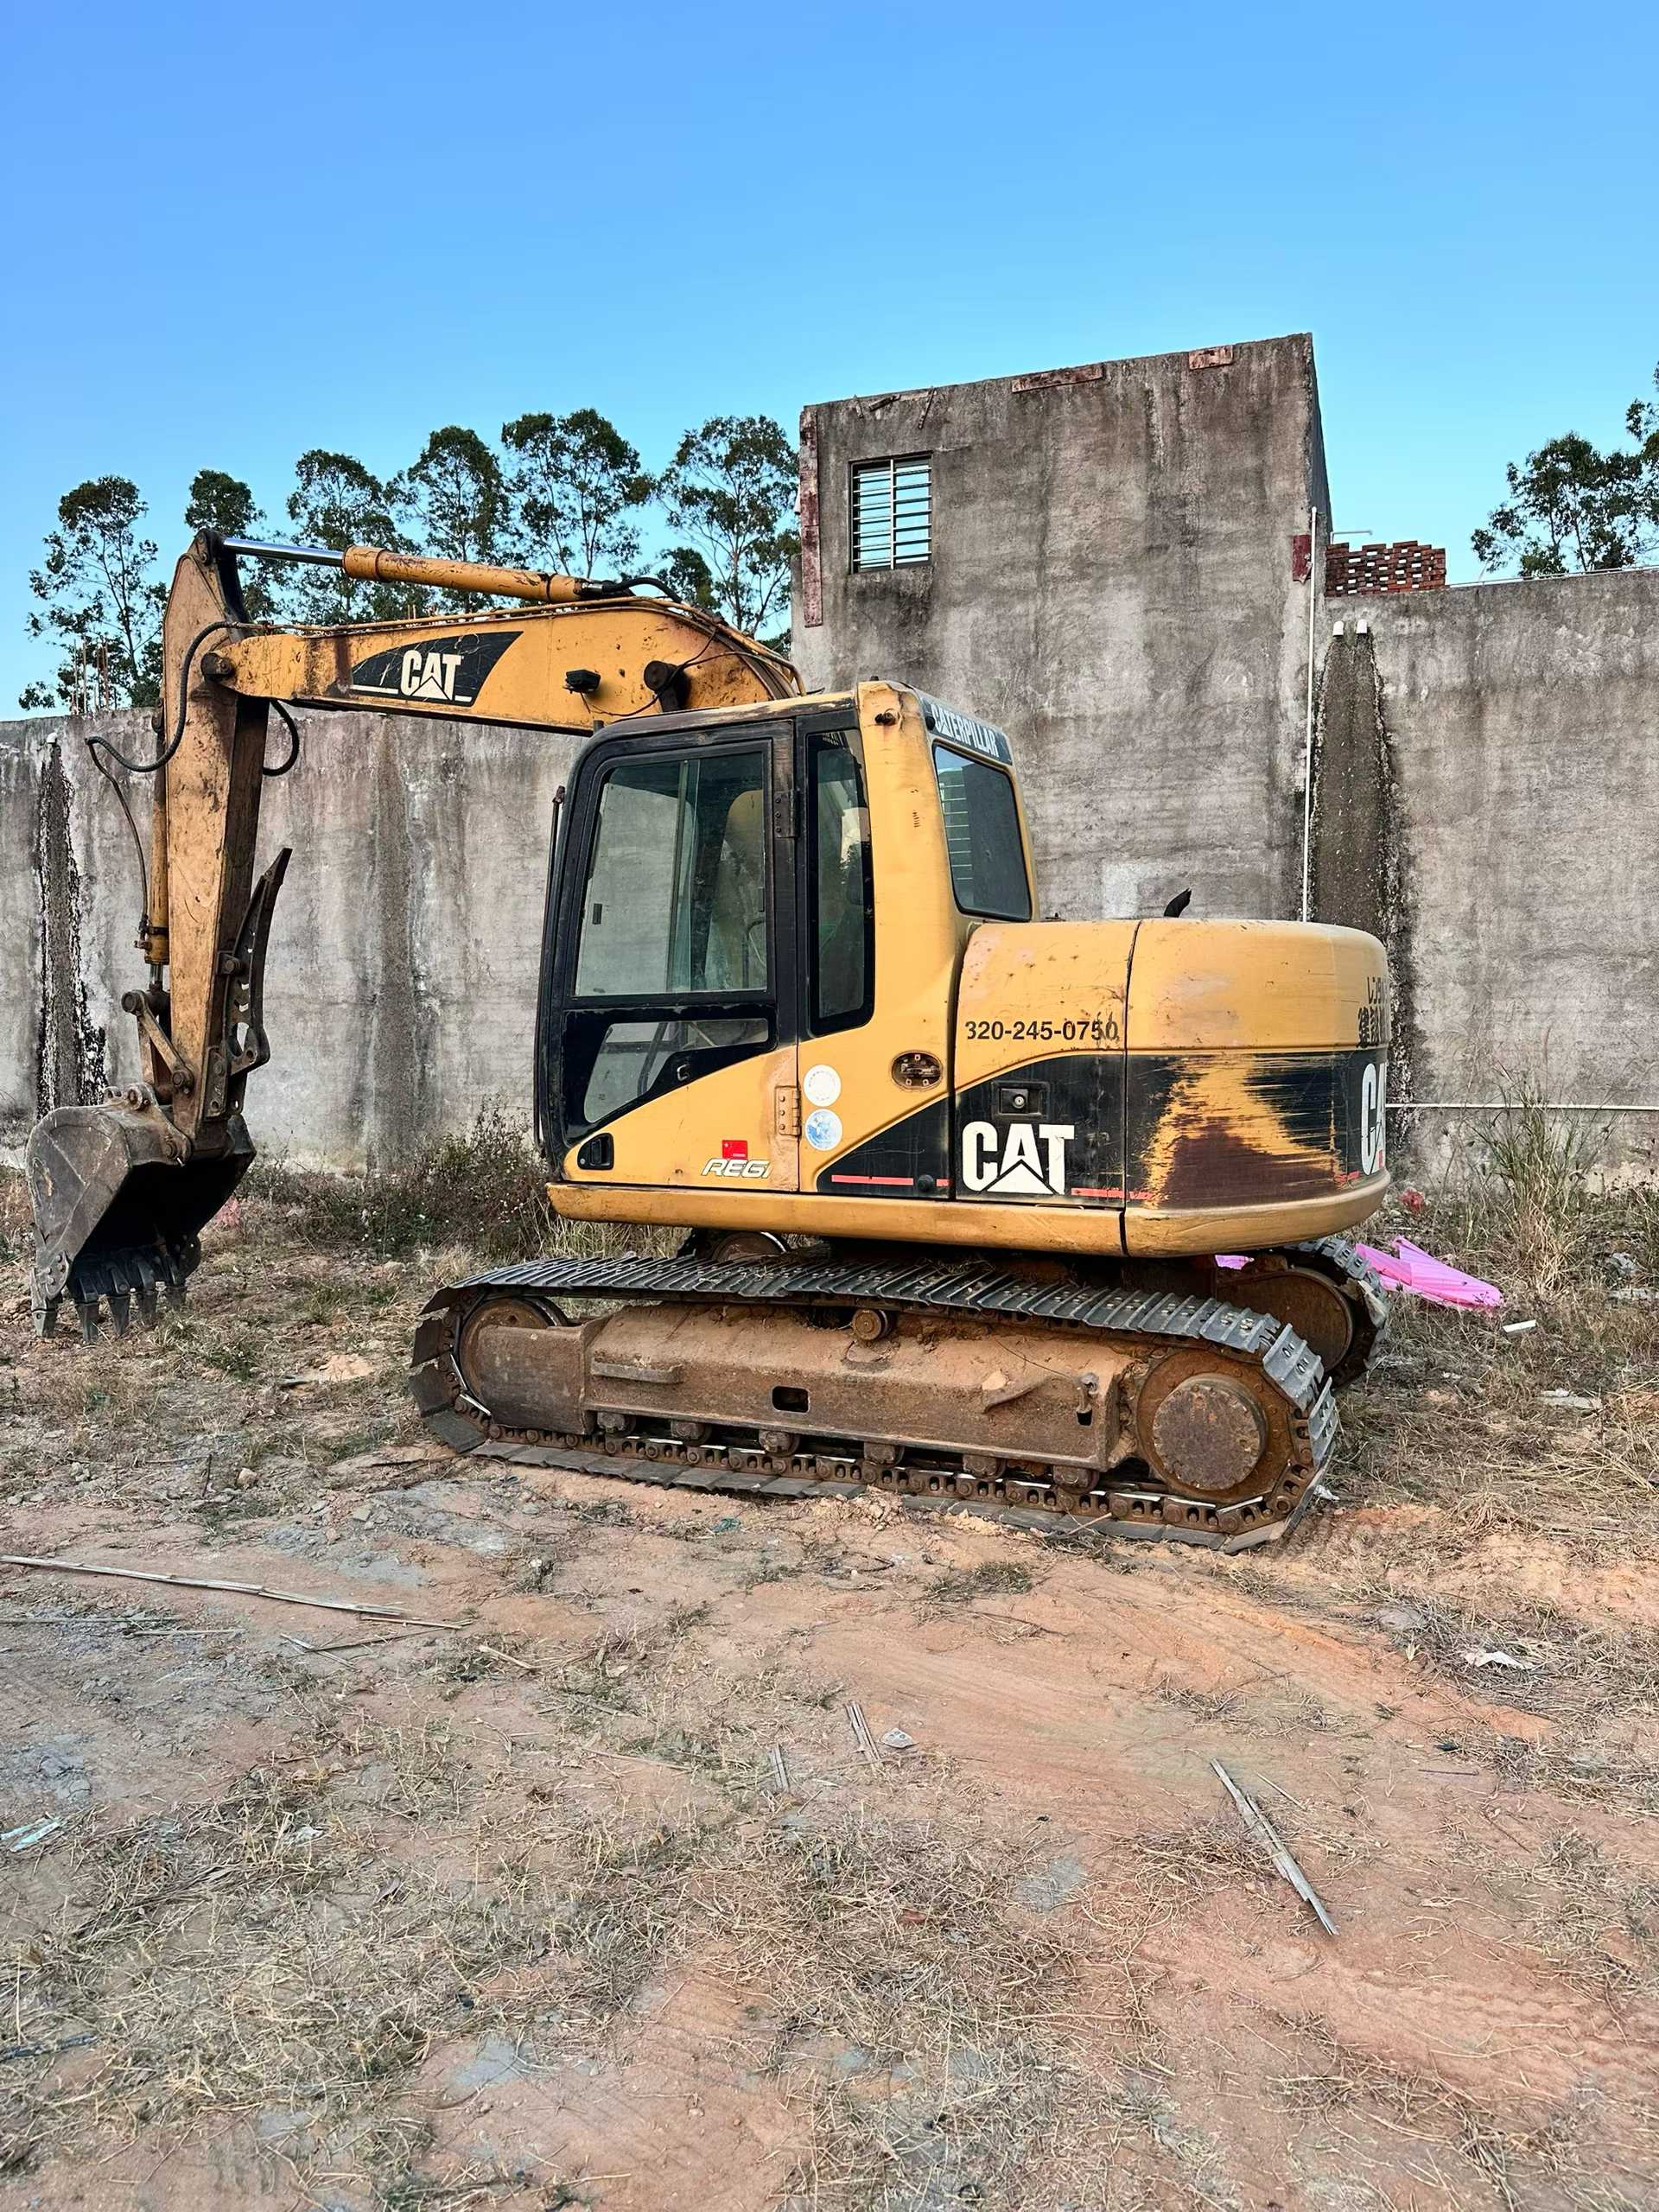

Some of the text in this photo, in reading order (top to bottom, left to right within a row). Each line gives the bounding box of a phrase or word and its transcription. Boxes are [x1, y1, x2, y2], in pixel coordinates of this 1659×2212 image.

[400, 650, 463, 701] CAT
[931, 703, 1000, 758] CATERPILLAR
[965, 1020, 1119, 1041] 320-245-0750
[962, 1121, 1075, 1195] CAT
